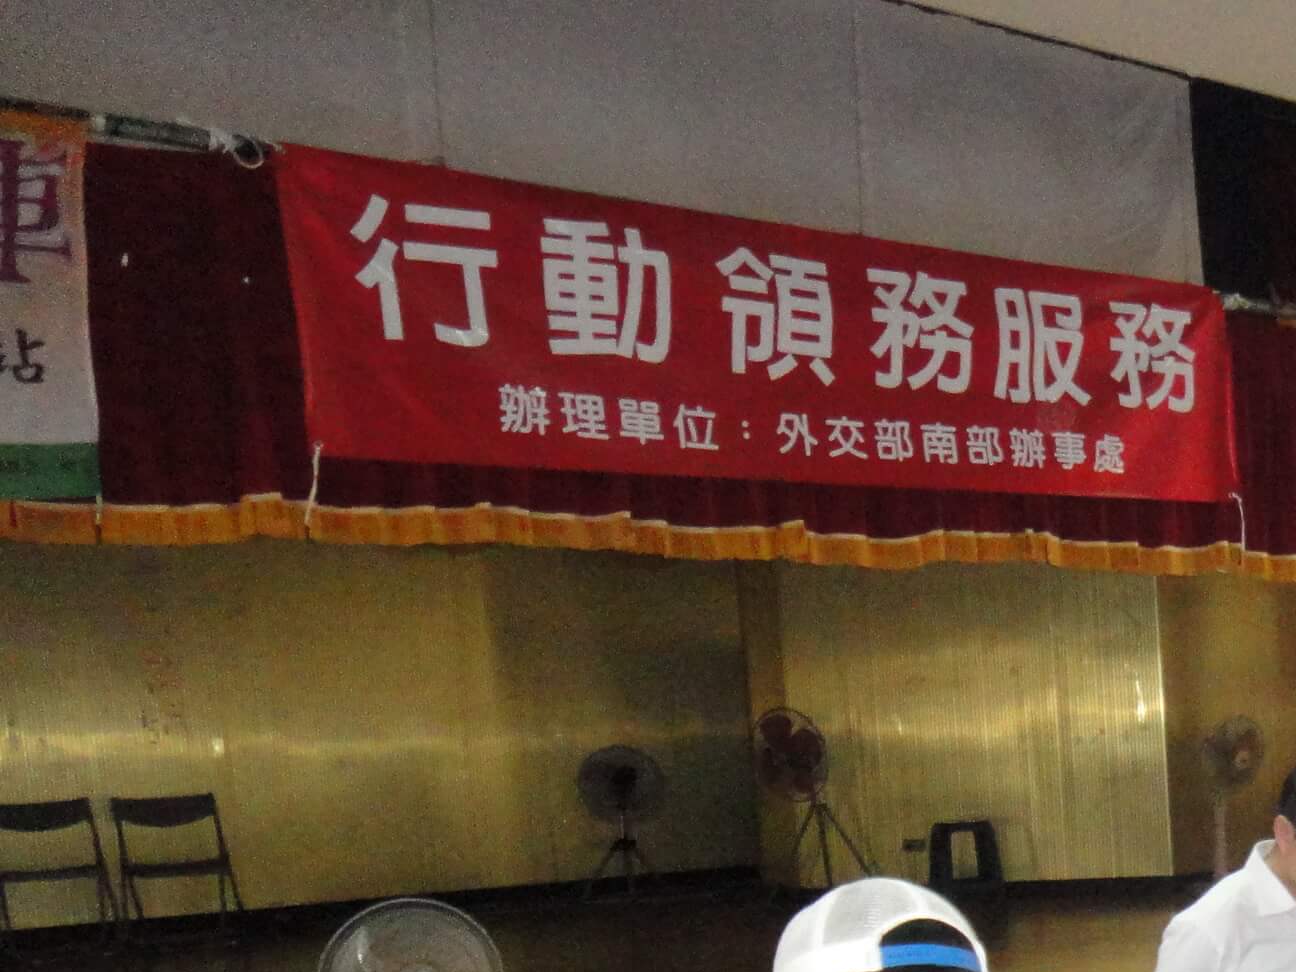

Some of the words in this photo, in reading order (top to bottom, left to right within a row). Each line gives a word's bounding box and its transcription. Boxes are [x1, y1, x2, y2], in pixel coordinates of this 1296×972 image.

[350, 194, 1196, 413] 行動領務服務
